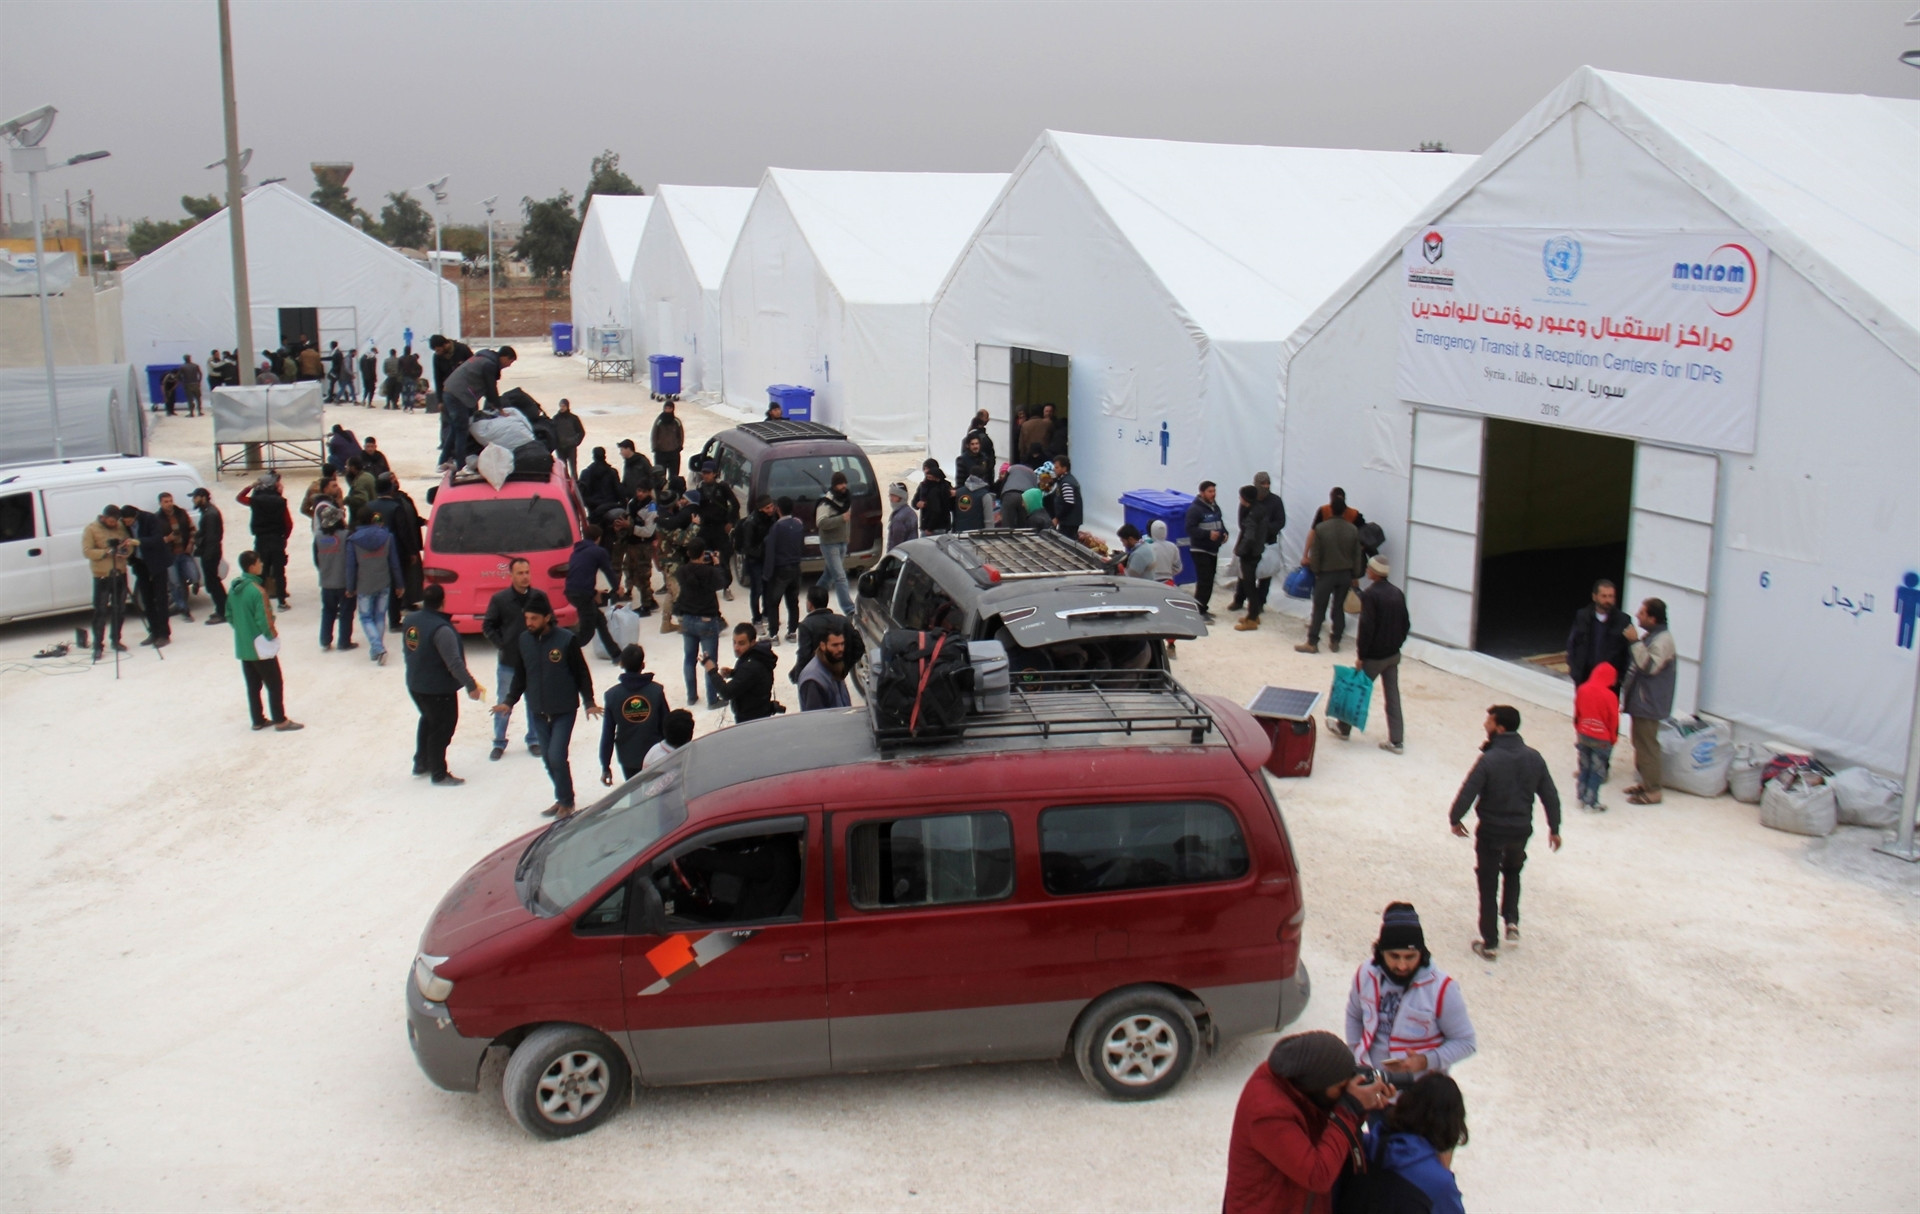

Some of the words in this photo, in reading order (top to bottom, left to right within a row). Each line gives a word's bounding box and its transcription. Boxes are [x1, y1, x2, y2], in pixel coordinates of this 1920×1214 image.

[1672, 262, 1744, 283] marom
[1412, 298, 1479, 323] للوافدين
[1482, 306, 1533, 329] مؤقت
[1537, 315, 1587, 337] وعبور
[1591, 316, 1670, 342] استقبال
[1674, 324, 1733, 351] مراكز
[1415, 329, 1476, 353] Emergency
[1480, 337, 1519, 356] Transit
[1522, 342, 1531, 358] &
[1535, 344, 1599, 367] Reception
[1603, 352, 1657, 375] Centers
[1661, 360, 1681, 378] for
[1685, 363, 1723, 383] IDPs
[1483, 366, 1506, 382] Syria
[1515, 371, 1537, 385] Idleb
[1546, 375, 1578, 392] ادلب
[1588, 379, 1626, 399] سوريا
[1541, 403, 1560, 417] 2016
[1760, 571, 1770, 588] 6
